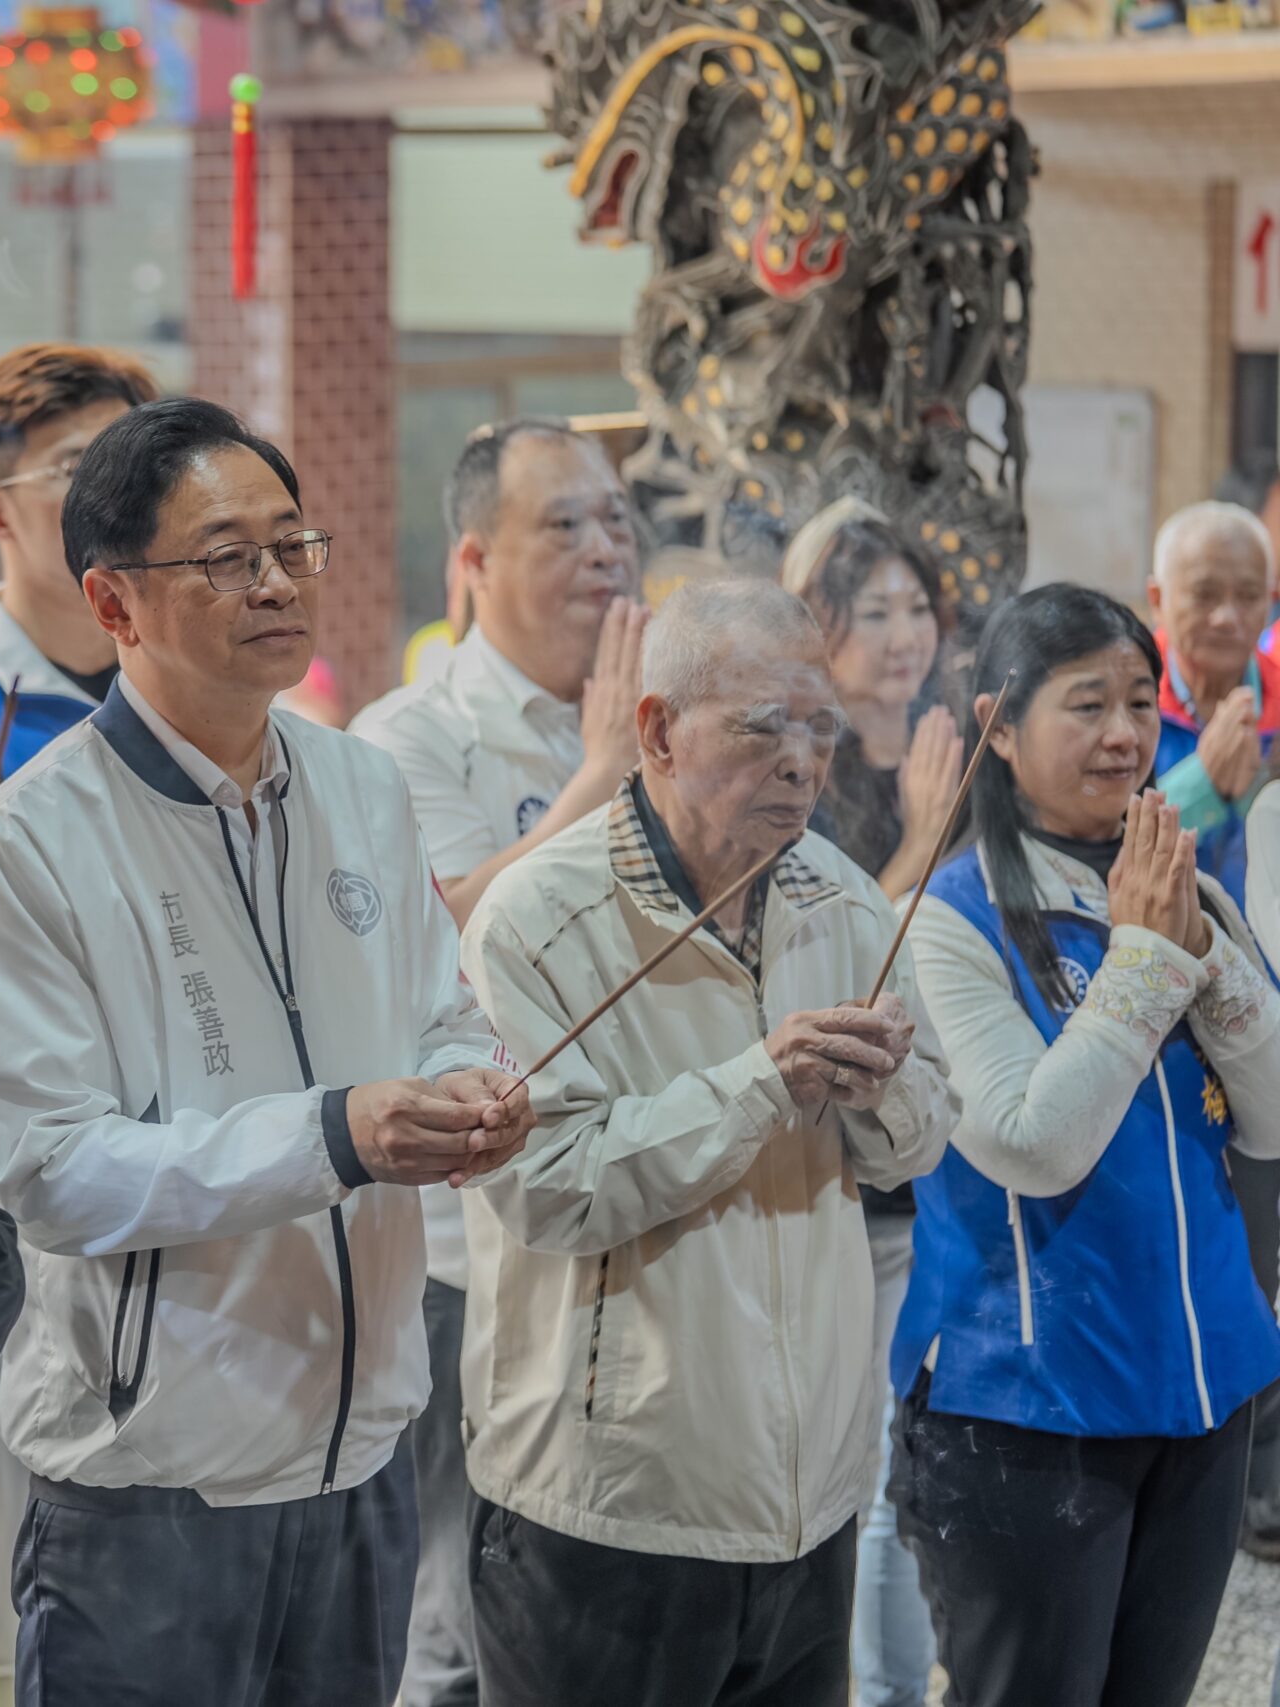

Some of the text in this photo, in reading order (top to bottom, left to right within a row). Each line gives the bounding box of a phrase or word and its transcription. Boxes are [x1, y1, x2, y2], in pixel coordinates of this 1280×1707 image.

[160, 890, 234, 1077] 市長 張善政
